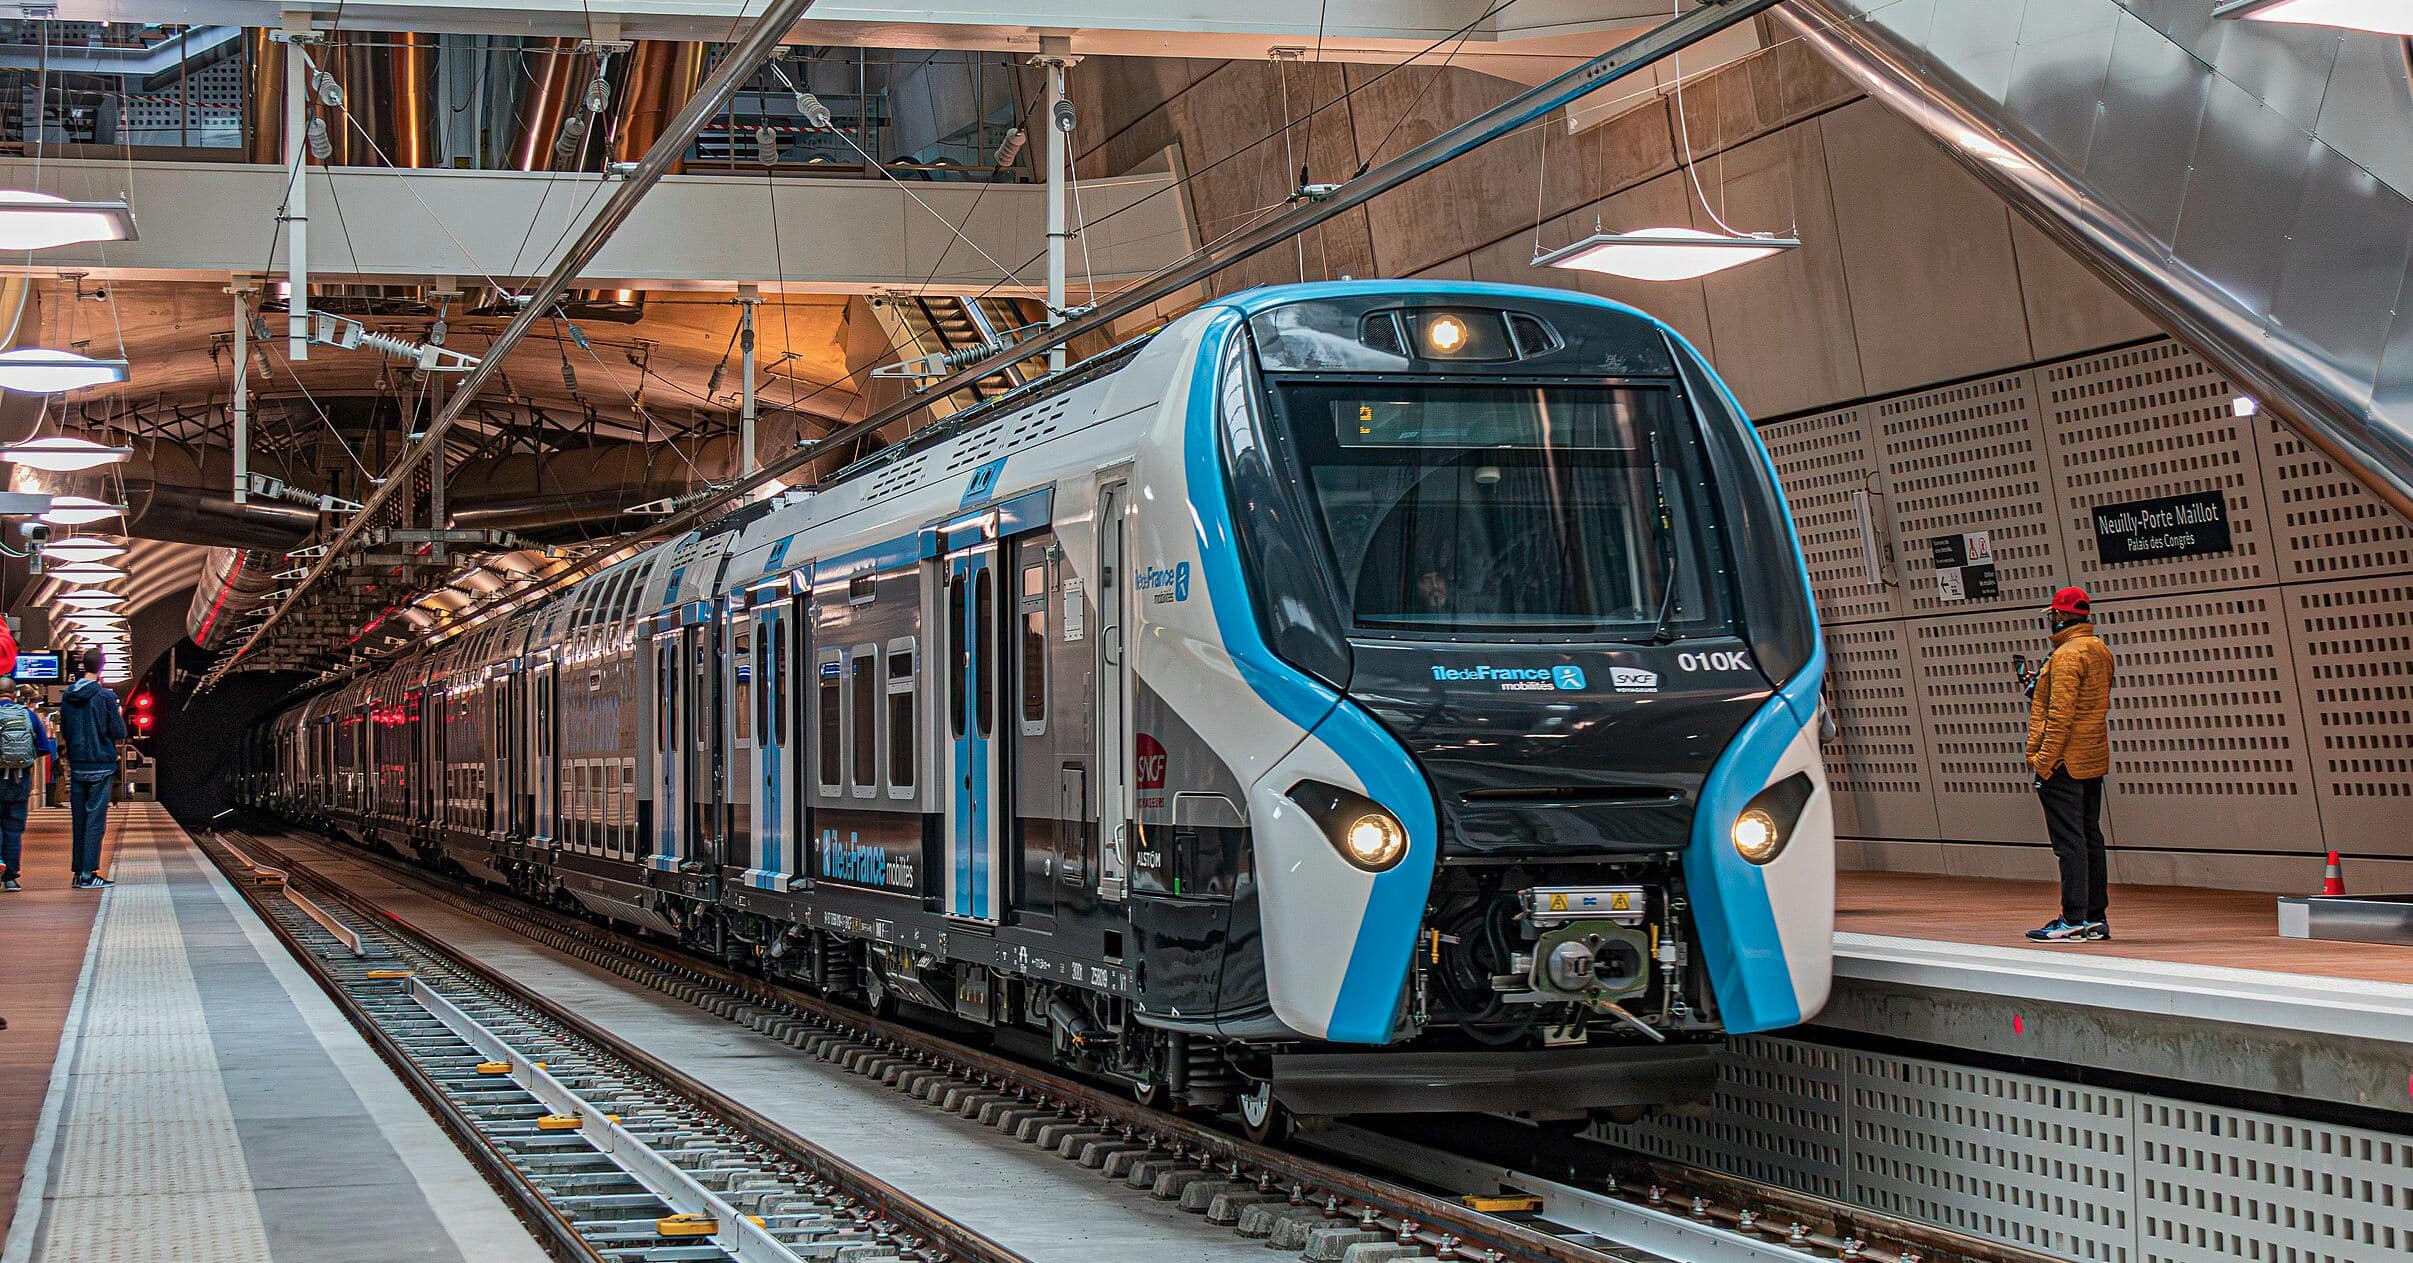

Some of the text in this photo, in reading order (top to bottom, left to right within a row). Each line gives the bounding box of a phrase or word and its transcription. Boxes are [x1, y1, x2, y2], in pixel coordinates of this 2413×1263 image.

[2098, 502, 2219, 536] Neuilly-Porte Maillot
[2127, 531, 2195, 551] Palais des Congrès
[1677, 651, 1752, 671] 010K
[1501, 680, 1555, 691] mobilités
[1617, 674, 1653, 684] SNCF
[1138, 754, 1165, 782] SNCF
[1136, 850, 1161, 868] ALSTOM
[886, 854, 914, 888] mobilités
